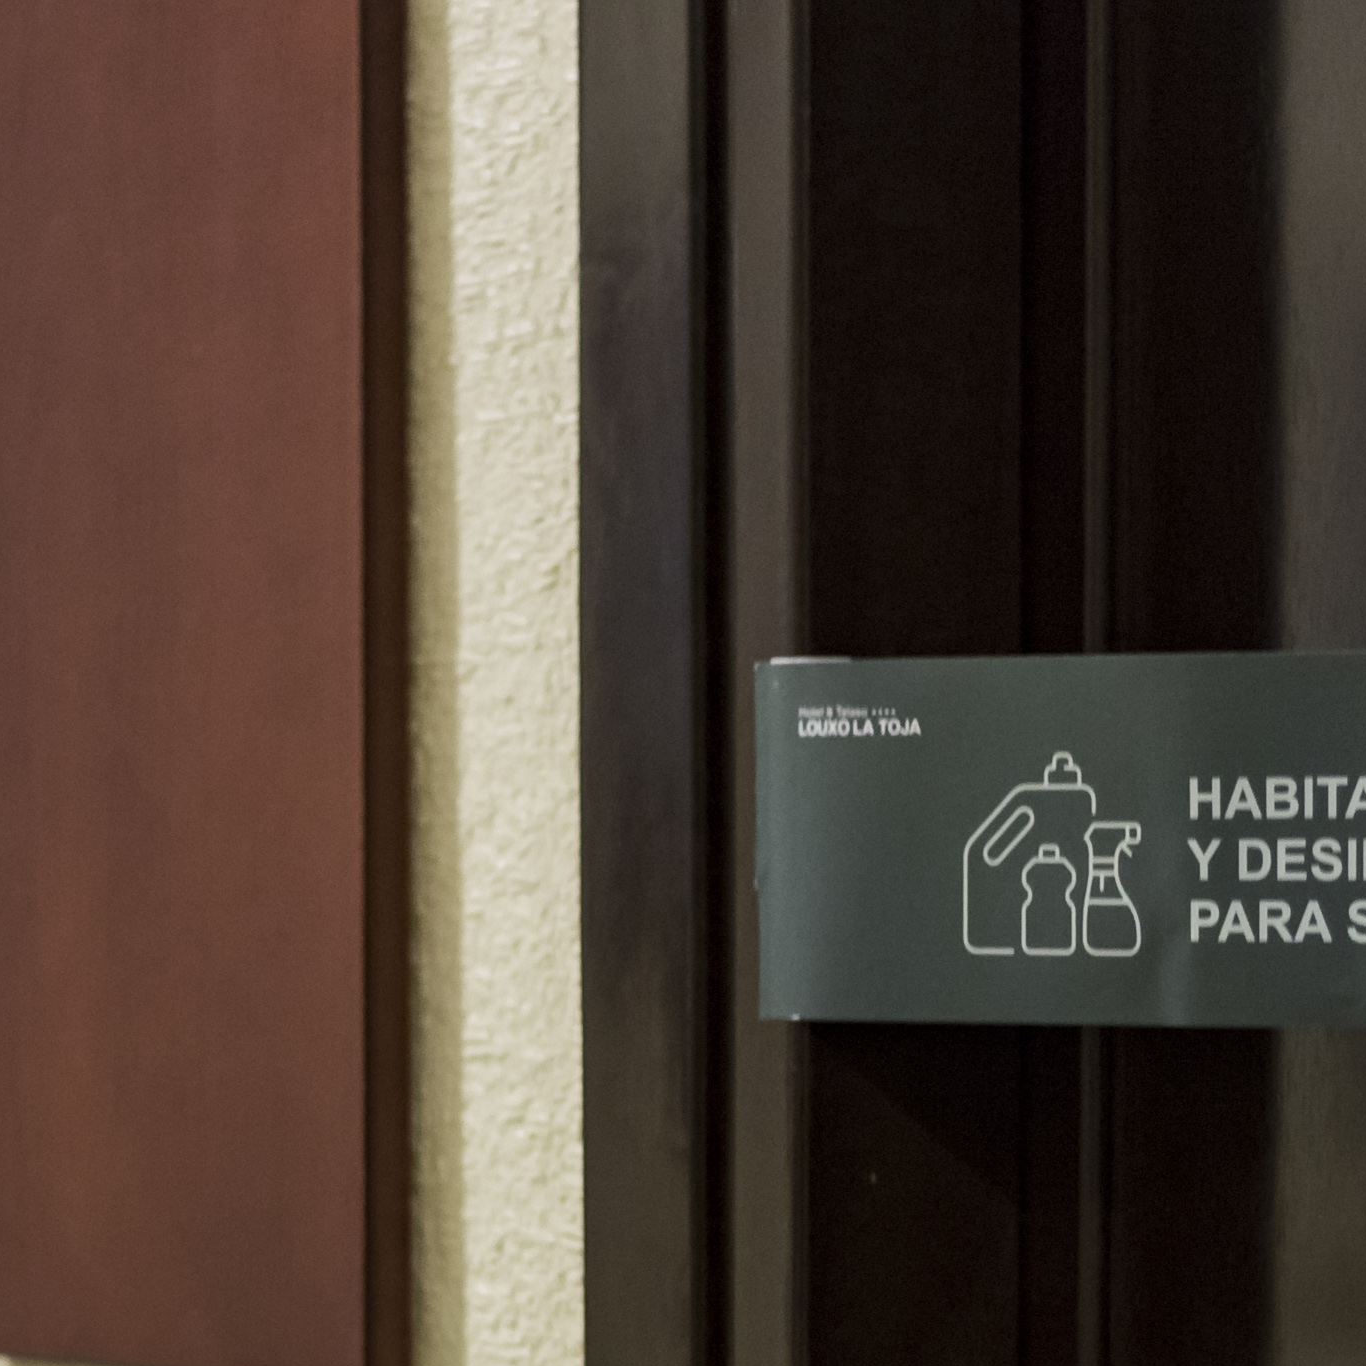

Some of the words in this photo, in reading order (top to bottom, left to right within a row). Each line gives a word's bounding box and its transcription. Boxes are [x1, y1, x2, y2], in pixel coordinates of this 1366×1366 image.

[798, 717, 851, 737] LOUXO
[852, 717, 874, 736] LA
[878, 717, 922, 736] TOJA
[1187, 837, 1222, 883] Y
[1189, 898, 1333, 944] PARA
